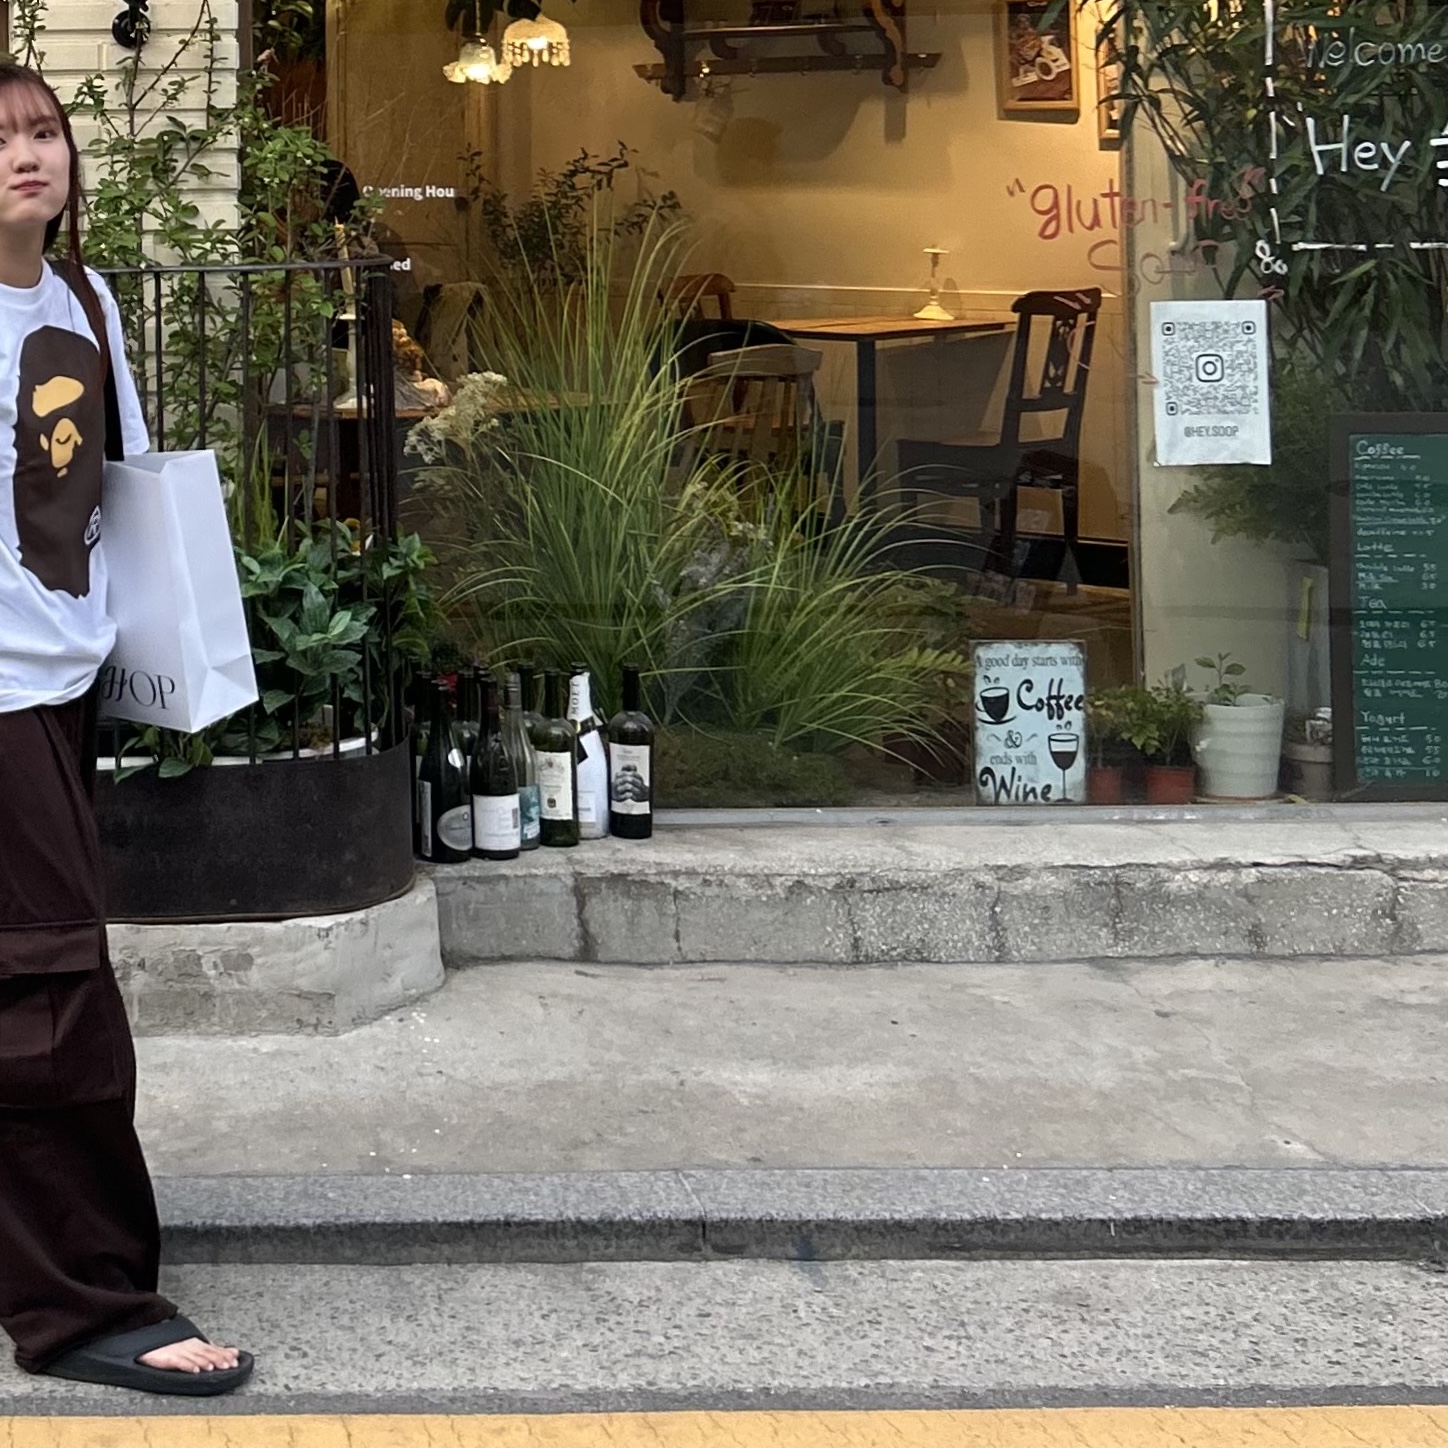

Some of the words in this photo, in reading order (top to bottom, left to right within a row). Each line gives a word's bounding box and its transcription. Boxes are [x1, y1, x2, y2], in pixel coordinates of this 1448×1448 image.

[1305, 113, 1412, 192] Hey
[362, 184, 424, 201] Oening
[1356, 439, 1405, 456] Coffee
[1357, 541, 1395, 552] Latte
[1358, 595, 1388, 609] Tea
[985, 654, 1009, 671] good
[1012, 654, 1029, 670] day
[1032, 654, 1058, 667] starts
[1360, 654, 1386, 667] Ade
[1016, 678, 1085, 721] Coffee
[1360, 711, 1406, 726] Yogurt
[1004, 729, 1023, 749] &
[990, 752, 1013, 766] ends
[1015, 752, 1037, 766] with
[979, 766, 1052, 805] Wine
